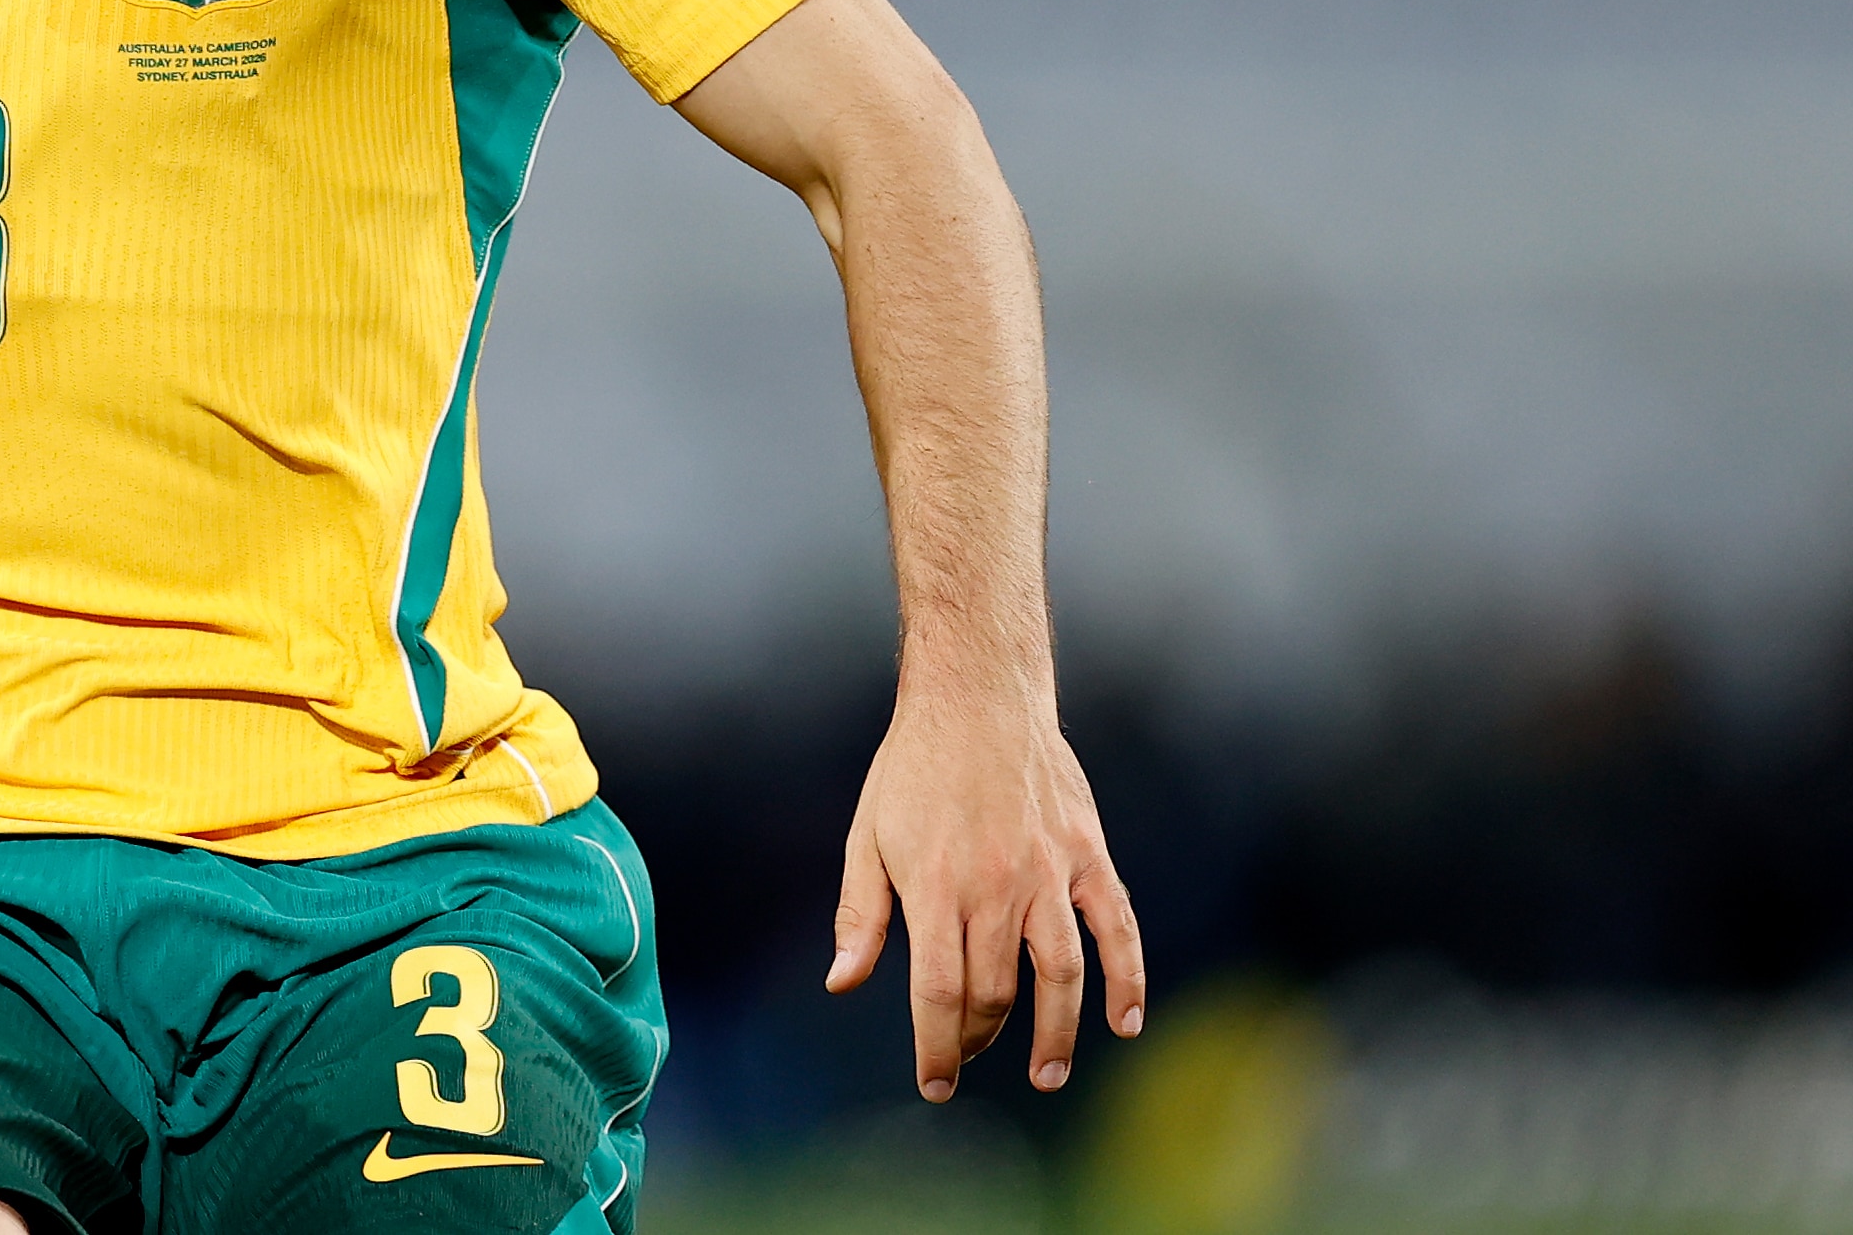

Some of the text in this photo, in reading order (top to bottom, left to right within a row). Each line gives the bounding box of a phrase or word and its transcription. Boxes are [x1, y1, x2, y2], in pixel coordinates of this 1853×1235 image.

[118, 43, 185, 54] AUSTRALIA
[206, 37, 277, 53] CAMEROON
[128, 53, 267, 69] FRIDAY 27 MARCH 2026
[136, 68, 259, 82] SYDNEY, AUSTRALIA
[390, 944, 506, 1137] 3
